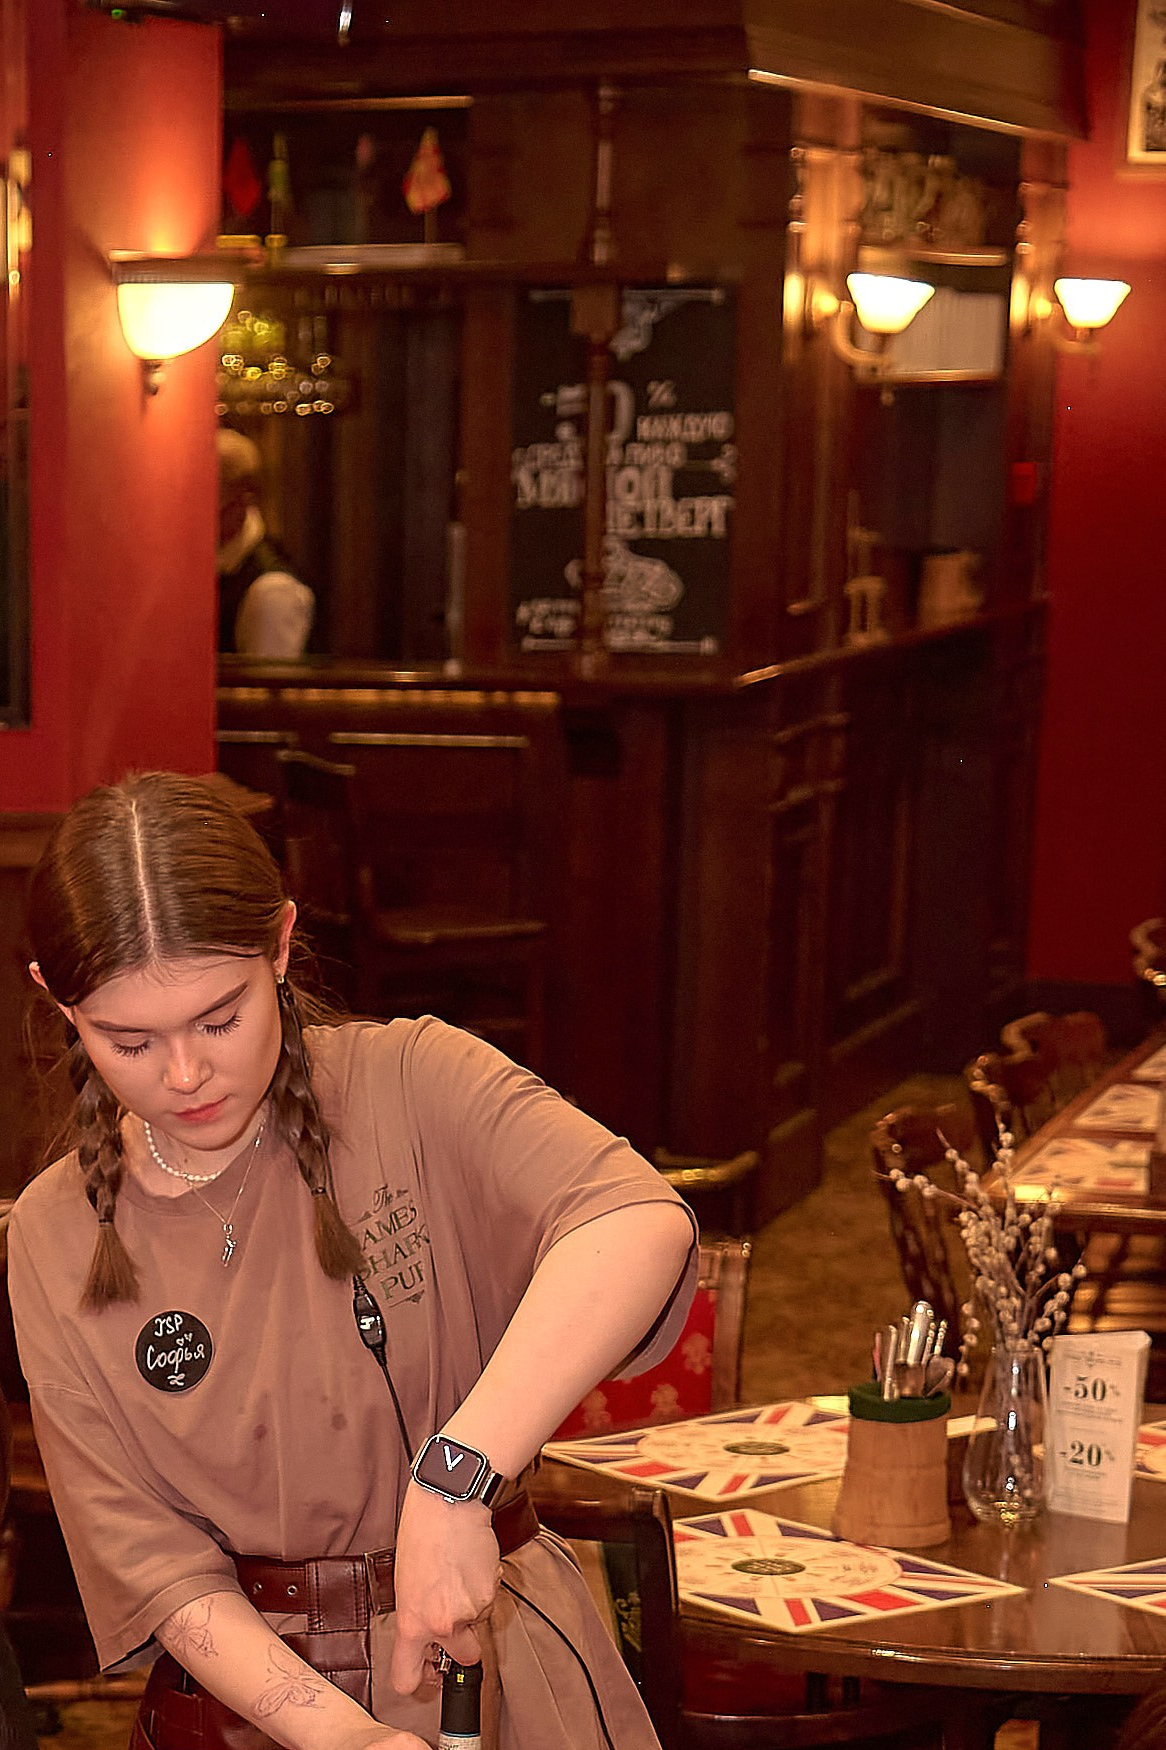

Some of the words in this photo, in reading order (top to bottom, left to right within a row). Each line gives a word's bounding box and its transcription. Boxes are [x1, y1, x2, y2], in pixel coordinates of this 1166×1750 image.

[372, 1182, 394, 1214] The
[361, 1199, 418, 1252] AMES
[154, 1313, 184, 1337] JSP
[146, 1343, 206, 1374] Софья
